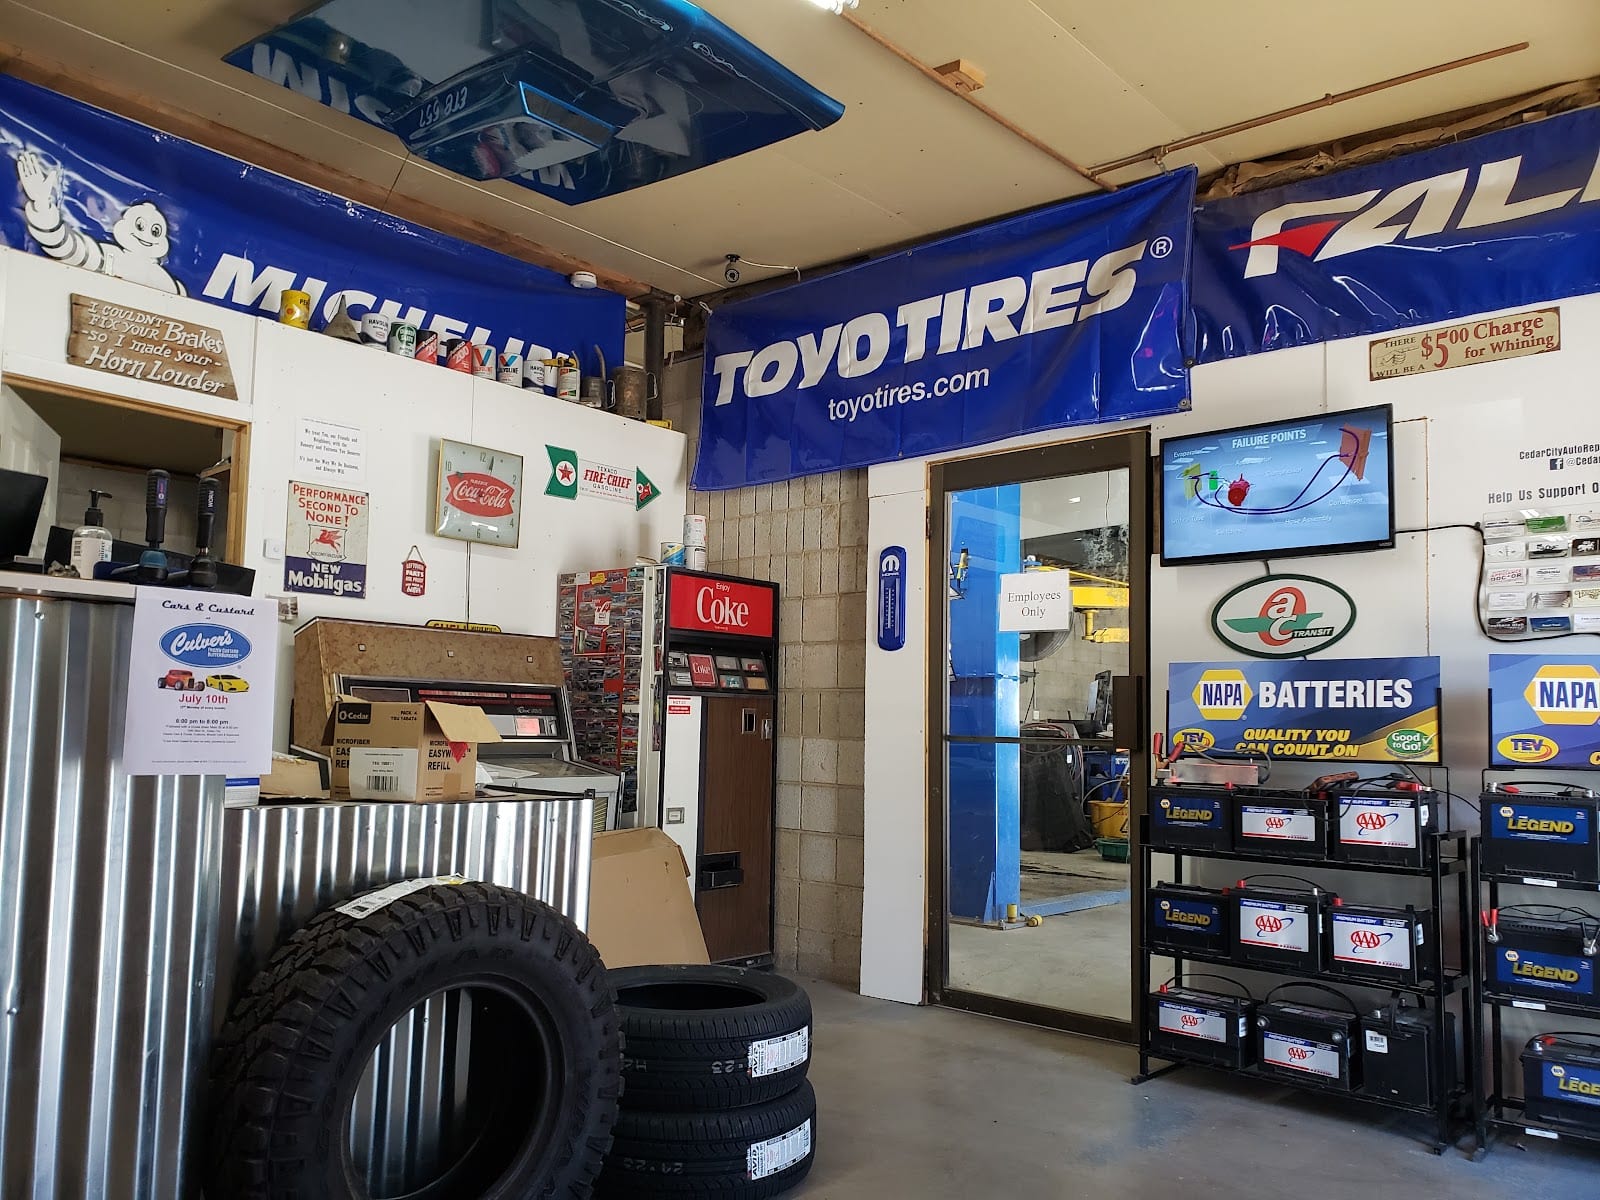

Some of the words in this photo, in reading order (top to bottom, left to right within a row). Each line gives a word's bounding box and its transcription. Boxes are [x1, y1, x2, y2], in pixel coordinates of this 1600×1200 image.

[1243, 146, 1600, 280] FAL
[88, 302, 98, 313] I
[712, 312, 891, 408] TOYO
[896, 239, 1147, 363] TIRES
[1473, 315, 1544, 340] Charge
[89, 314, 119, 331] FIX
[164, 320, 224, 354] Brakes
[129, 339, 172, 358] made
[1384, 336, 1416, 349] THERE
[1465, 346, 1485, 359] for
[1490, 334, 1554, 355] Whining
[85, 345, 146, 379] Horn
[147, 360, 225, 393] Louder
[1376, 369, 1400, 378] WILL
[1404, 366, 1417, 374] BE
[1418, 363, 1425, 371] A
[827, 364, 990, 422] toyotires.com
[1232, 434, 1268, 449] FAILURE
[1271, 429, 1306, 441] POINTS
[597, 465, 618, 475] TEXACO
[584, 469, 632, 489] FIRE-CHIEF
[293, 484, 366, 506] PERFORMANCE
[592, 483, 622, 494] GASOLINE
[1488, 492, 1513, 504] Help
[1519, 490, 1532, 501] Us
[1538, 484, 1586, 500] Support
[298, 497, 341, 513] SECOND
[344, 503, 358, 516] TO
[310, 562, 342, 575] NEW
[288, 570, 362, 596] Mobilgas
[715, 582, 731, 593] Enjoy
[1007, 590, 1061, 605] Employees
[162, 600, 191, 611] Cars
[195, 602, 205, 612] &
[208, 603, 255, 616] Custard
[696, 586, 749, 627] Coke
[1021, 605, 1046, 619] Only
[1293, 627, 1332, 638] TRANSIT
[170, 630, 233, 656] Culver's
[692, 662, 711, 675] Coke
[179, 694, 202, 705] July
[206, 694, 228, 704] 10th
[1203, 683, 1243, 706] NAPA
[1259, 678, 1413, 708] BATTERIES
[1539, 681, 1598, 708] NAPA
[1243, 728, 1309, 742] QUALITY
[1312, 729, 1351, 742] YOU
[1392, 732, 1420, 742] Good
[1235, 742, 1272, 755] CAN
[1274, 743, 1330, 756] COUNT
[1333, 744, 1360, 757] ON
[1402, 741, 1422, 752] Go!
[1511, 738, 1544, 751] TEV
[428, 761, 451, 771] REFILL
[1166, 807, 1212, 821] LEGEND
[1359, 813, 1383, 829] AAA
[1267, 817, 1284, 829] AAA
[1507, 817, 1575, 834] LEGEND
[1165, 911, 1211, 926] LEGEND
[1258, 915, 1280, 931] AAA
[1353, 931, 1378, 948] AAA
[1513, 962, 1579, 984] LEGEND
[1181, 1015, 1197, 1026] AAA
[1288, 1047, 1306, 1059] AAA
